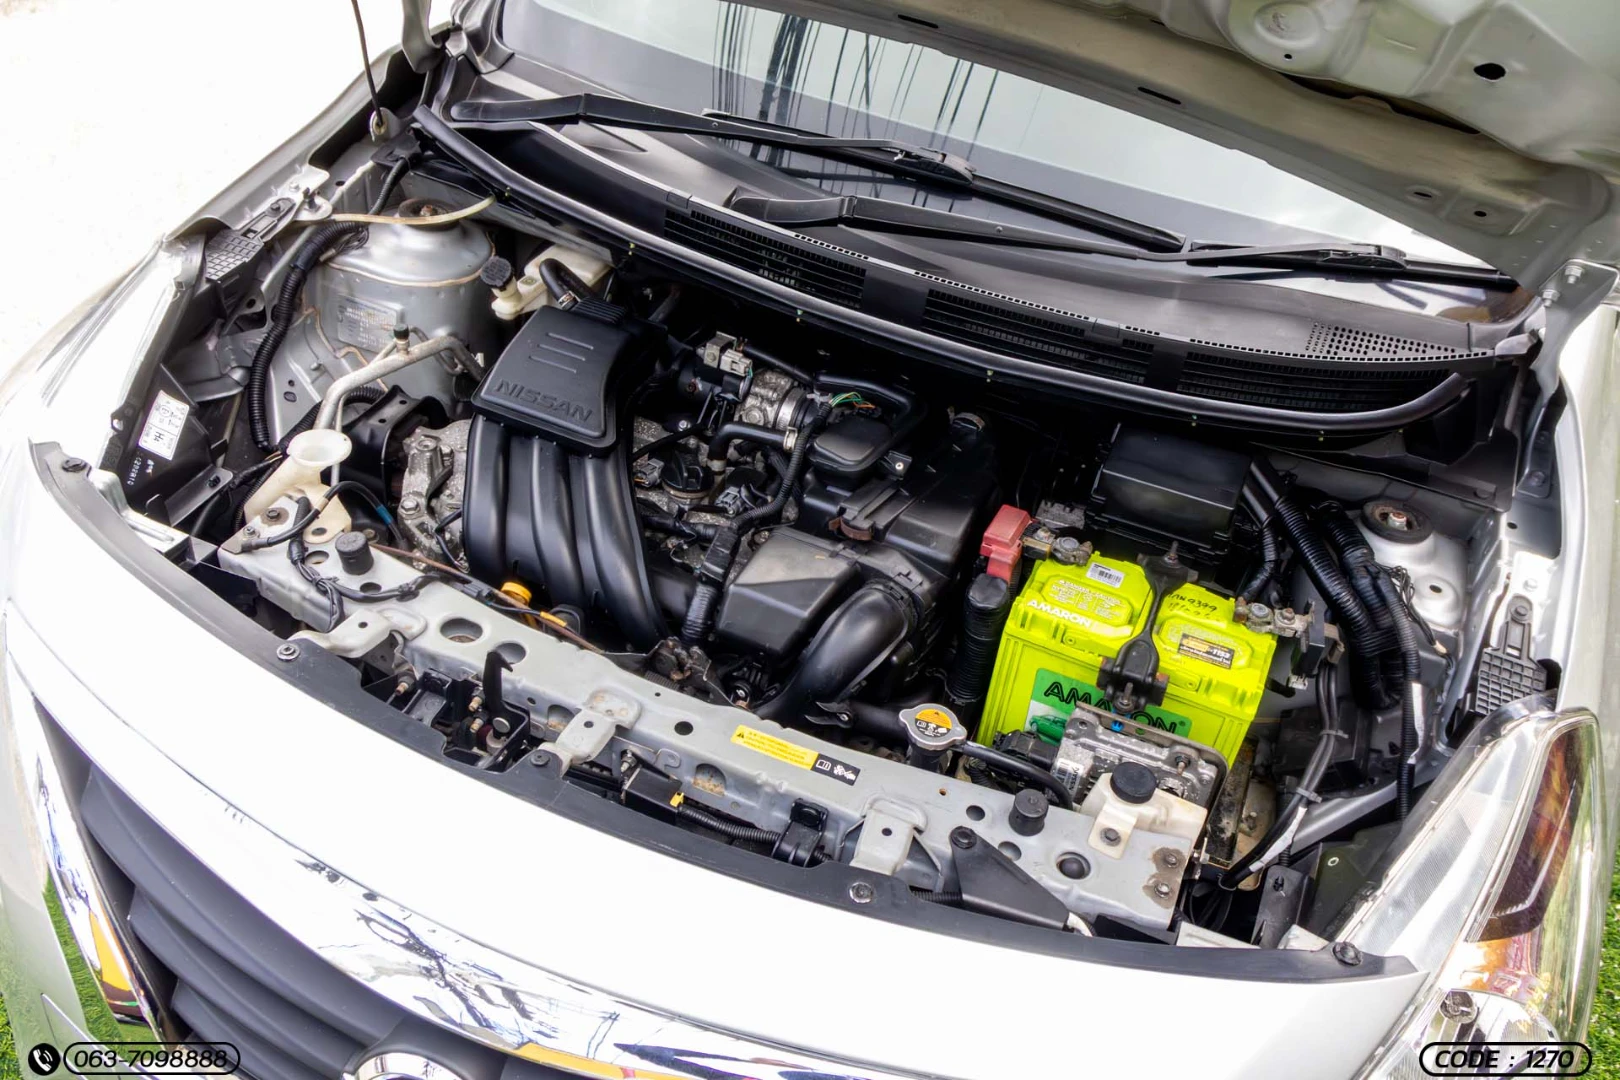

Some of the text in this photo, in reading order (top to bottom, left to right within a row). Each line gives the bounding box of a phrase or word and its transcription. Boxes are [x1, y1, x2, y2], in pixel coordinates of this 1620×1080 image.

[494, 379, 593, 422] NISSAN
[1027, 600, 1091, 628] AMARON
[1043, 681, 1177, 734] AMAON
